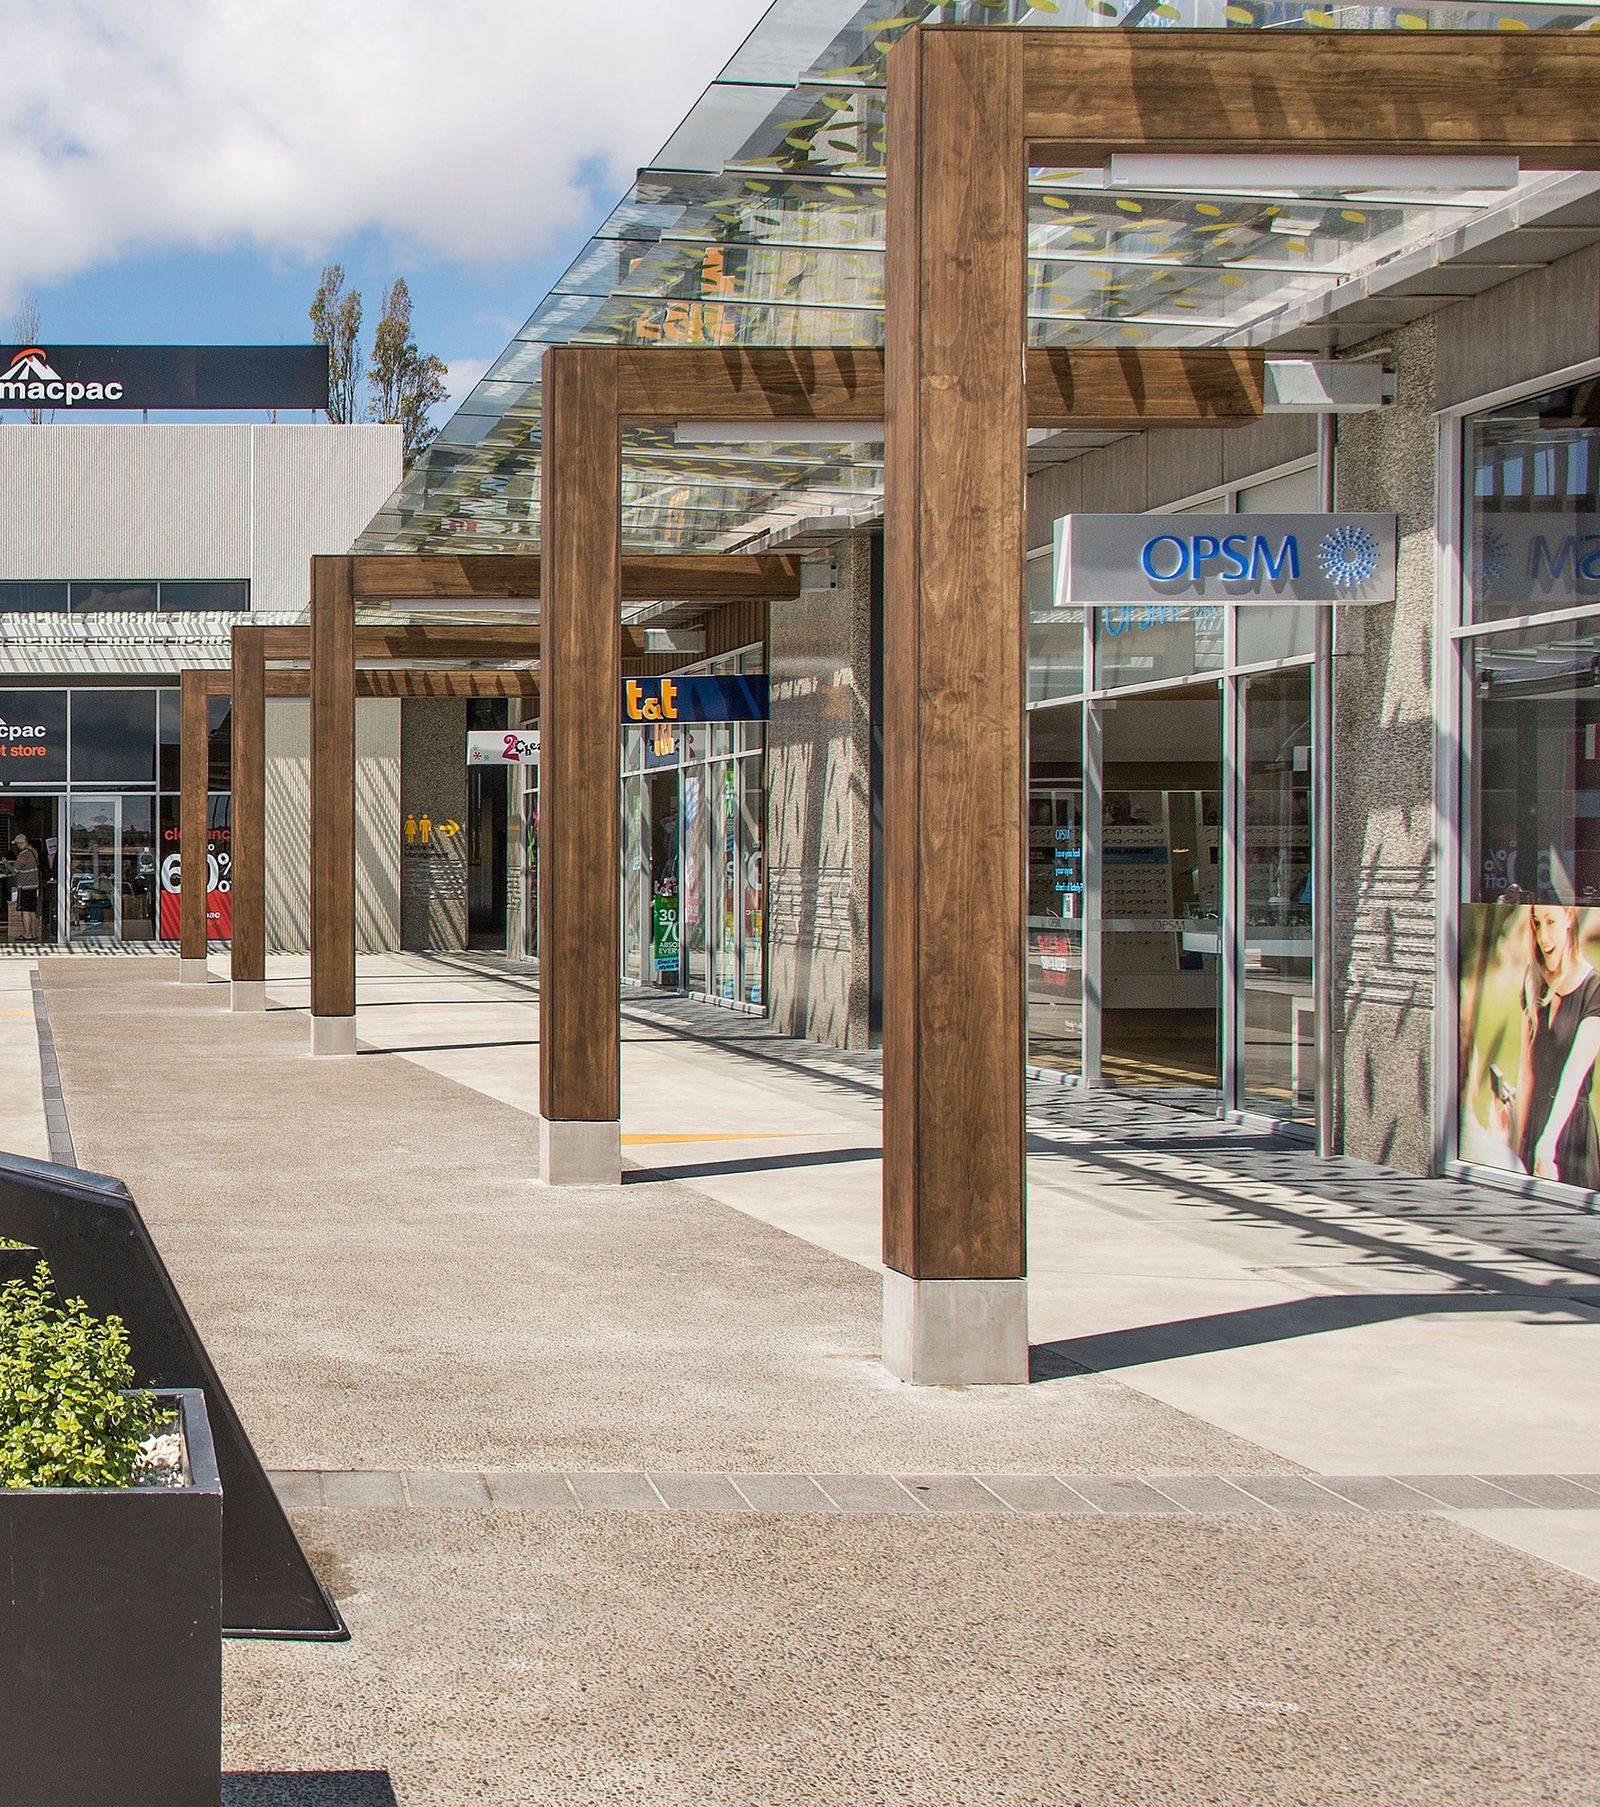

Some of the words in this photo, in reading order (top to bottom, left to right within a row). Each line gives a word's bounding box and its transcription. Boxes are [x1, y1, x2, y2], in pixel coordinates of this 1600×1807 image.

[1141, 535, 1300, 581] OPSM
[626, 679, 678, 720] t&t
[10, 744, 47, 757] store
